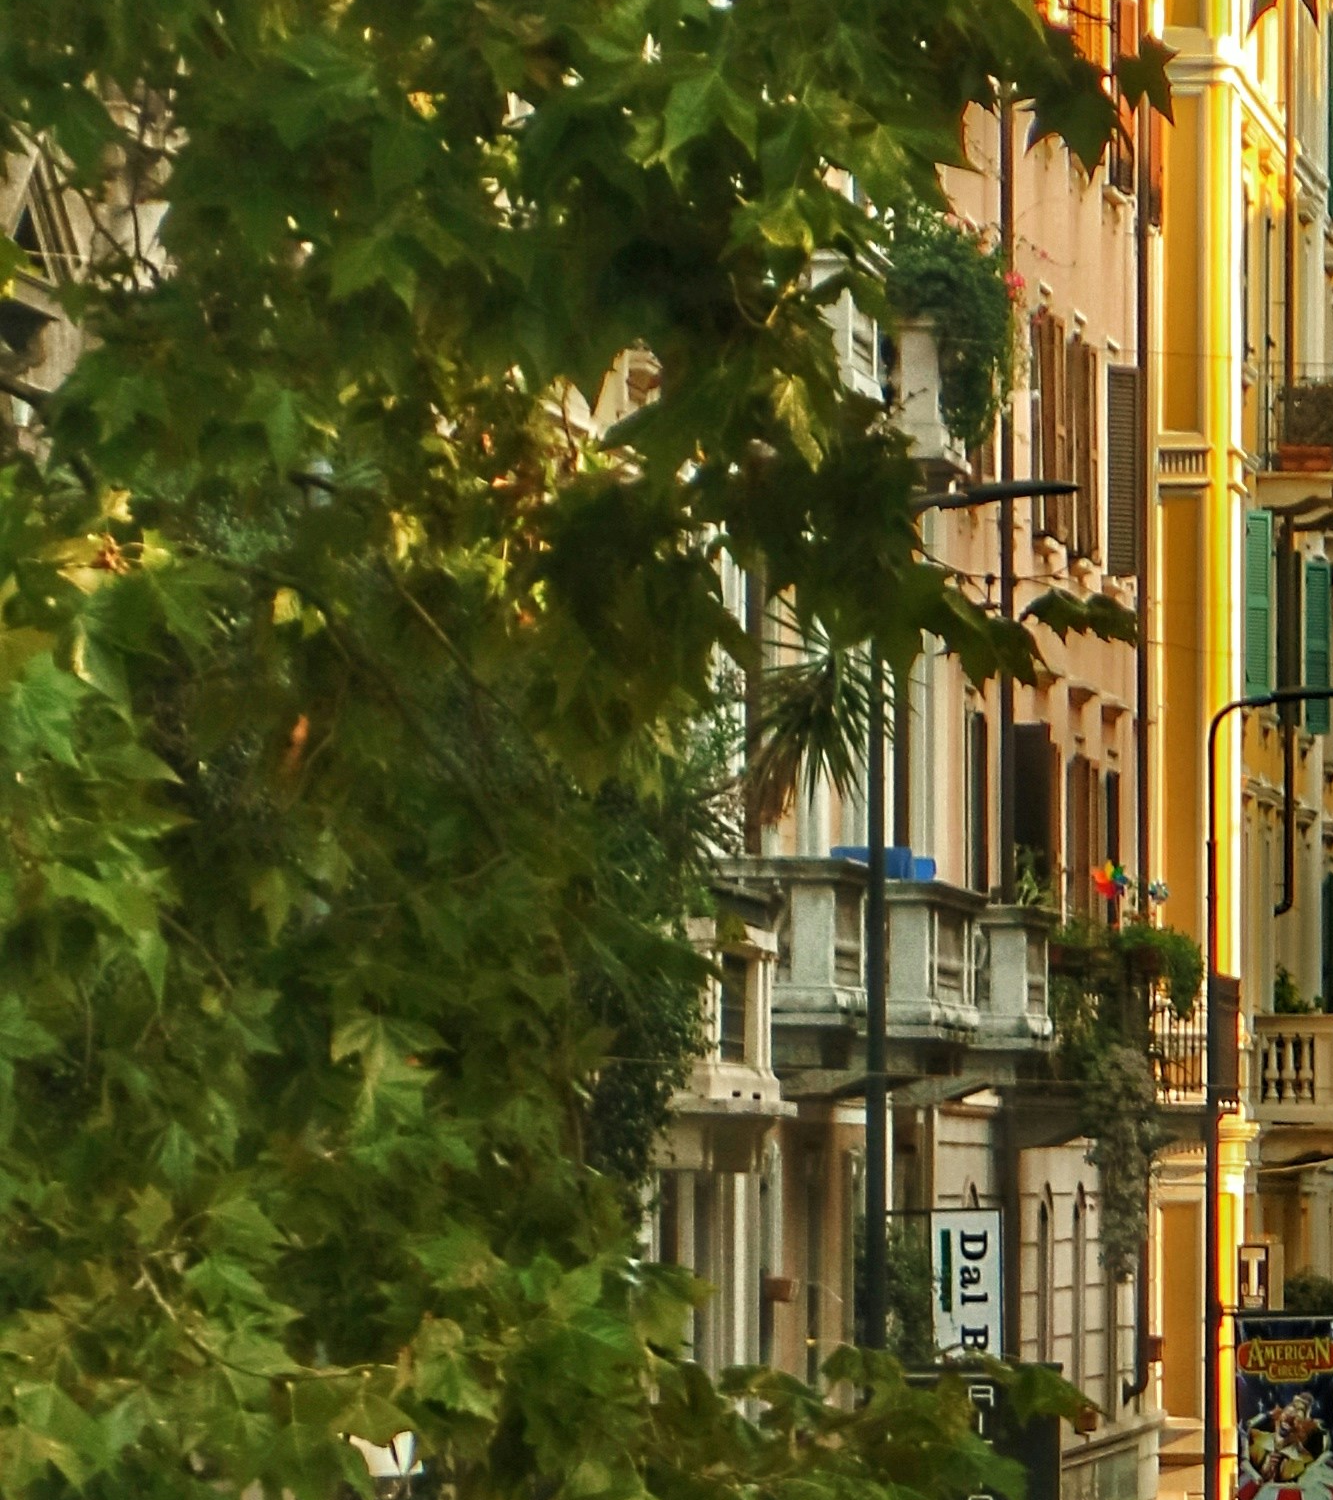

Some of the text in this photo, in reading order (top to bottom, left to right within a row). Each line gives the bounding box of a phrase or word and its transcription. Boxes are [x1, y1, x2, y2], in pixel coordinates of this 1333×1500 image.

[960, 1230, 988, 1306] Dal
[1246, 1336, 1331, 1368] AMERICAN
[1268, 1362, 1308, 1378] CIRCUS
